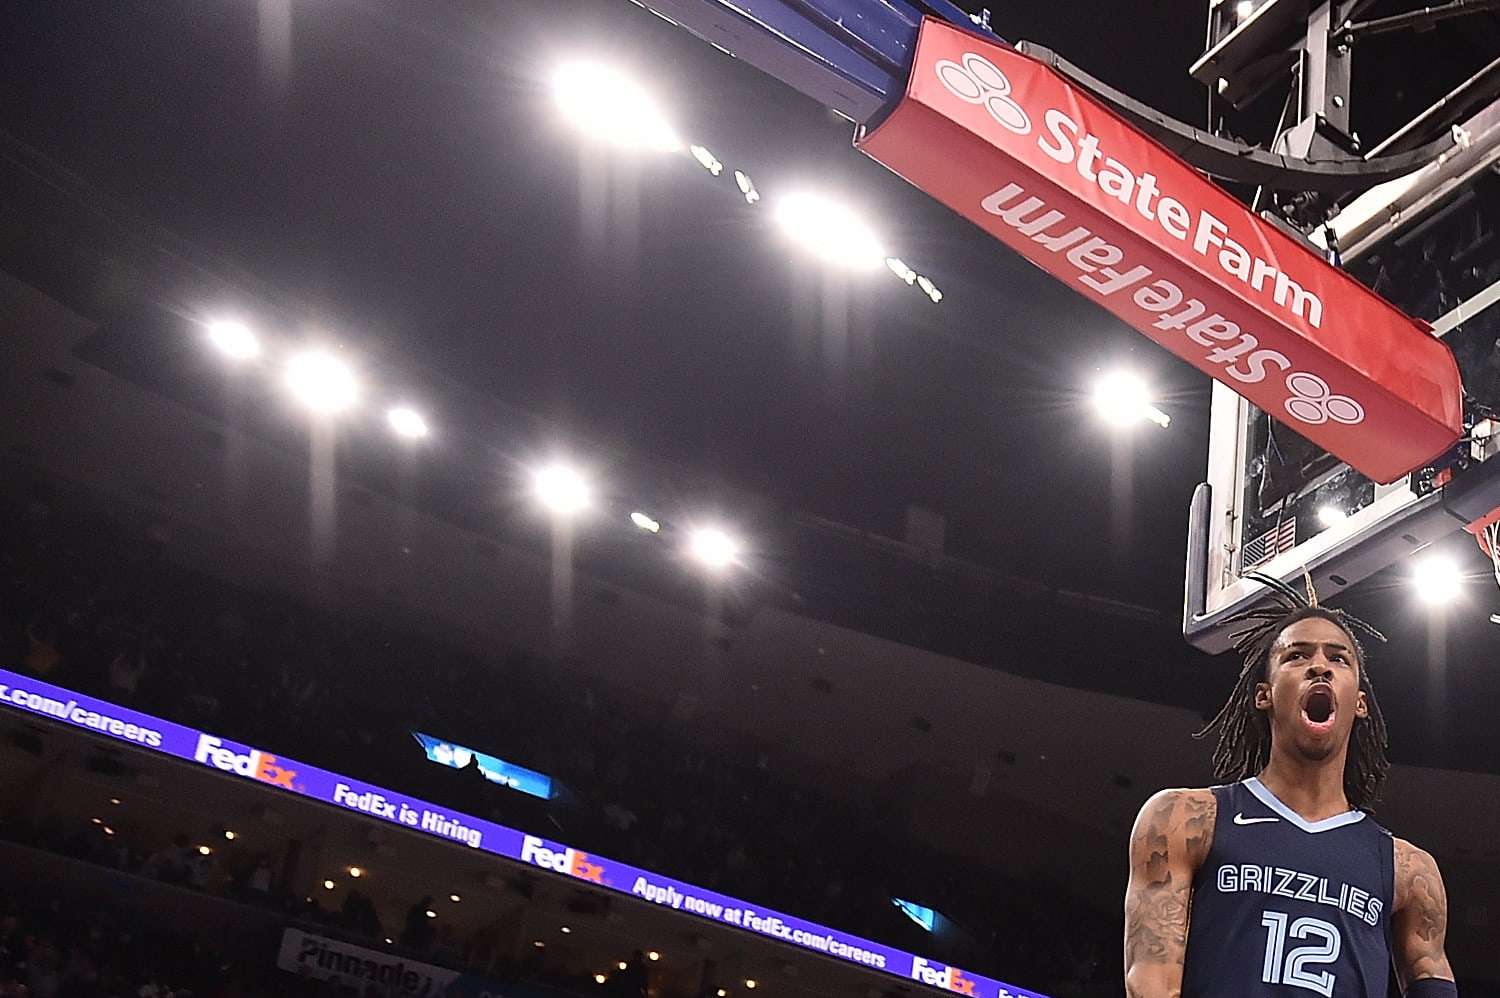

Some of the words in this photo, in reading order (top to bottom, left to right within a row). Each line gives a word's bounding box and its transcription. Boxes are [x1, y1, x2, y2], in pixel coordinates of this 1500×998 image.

[195, 733, 297, 790] FedEx
[334, 783, 396, 820] FedEx
[399, 804, 418, 827] is
[422, 811, 482, 848] Hiring
[521, 835, 605, 885] FedEx
[633, 877, 685, 909] Apply
[685, 893, 723, 918] now
[724, 906, 742, 926] at
[743, 910, 886, 968] FedEx.com/careers
[1217, 864, 1383, 926] GRIZZLIES
[911, 956, 976, 997] FedEx
[1262, 910, 1341, 998] 12
